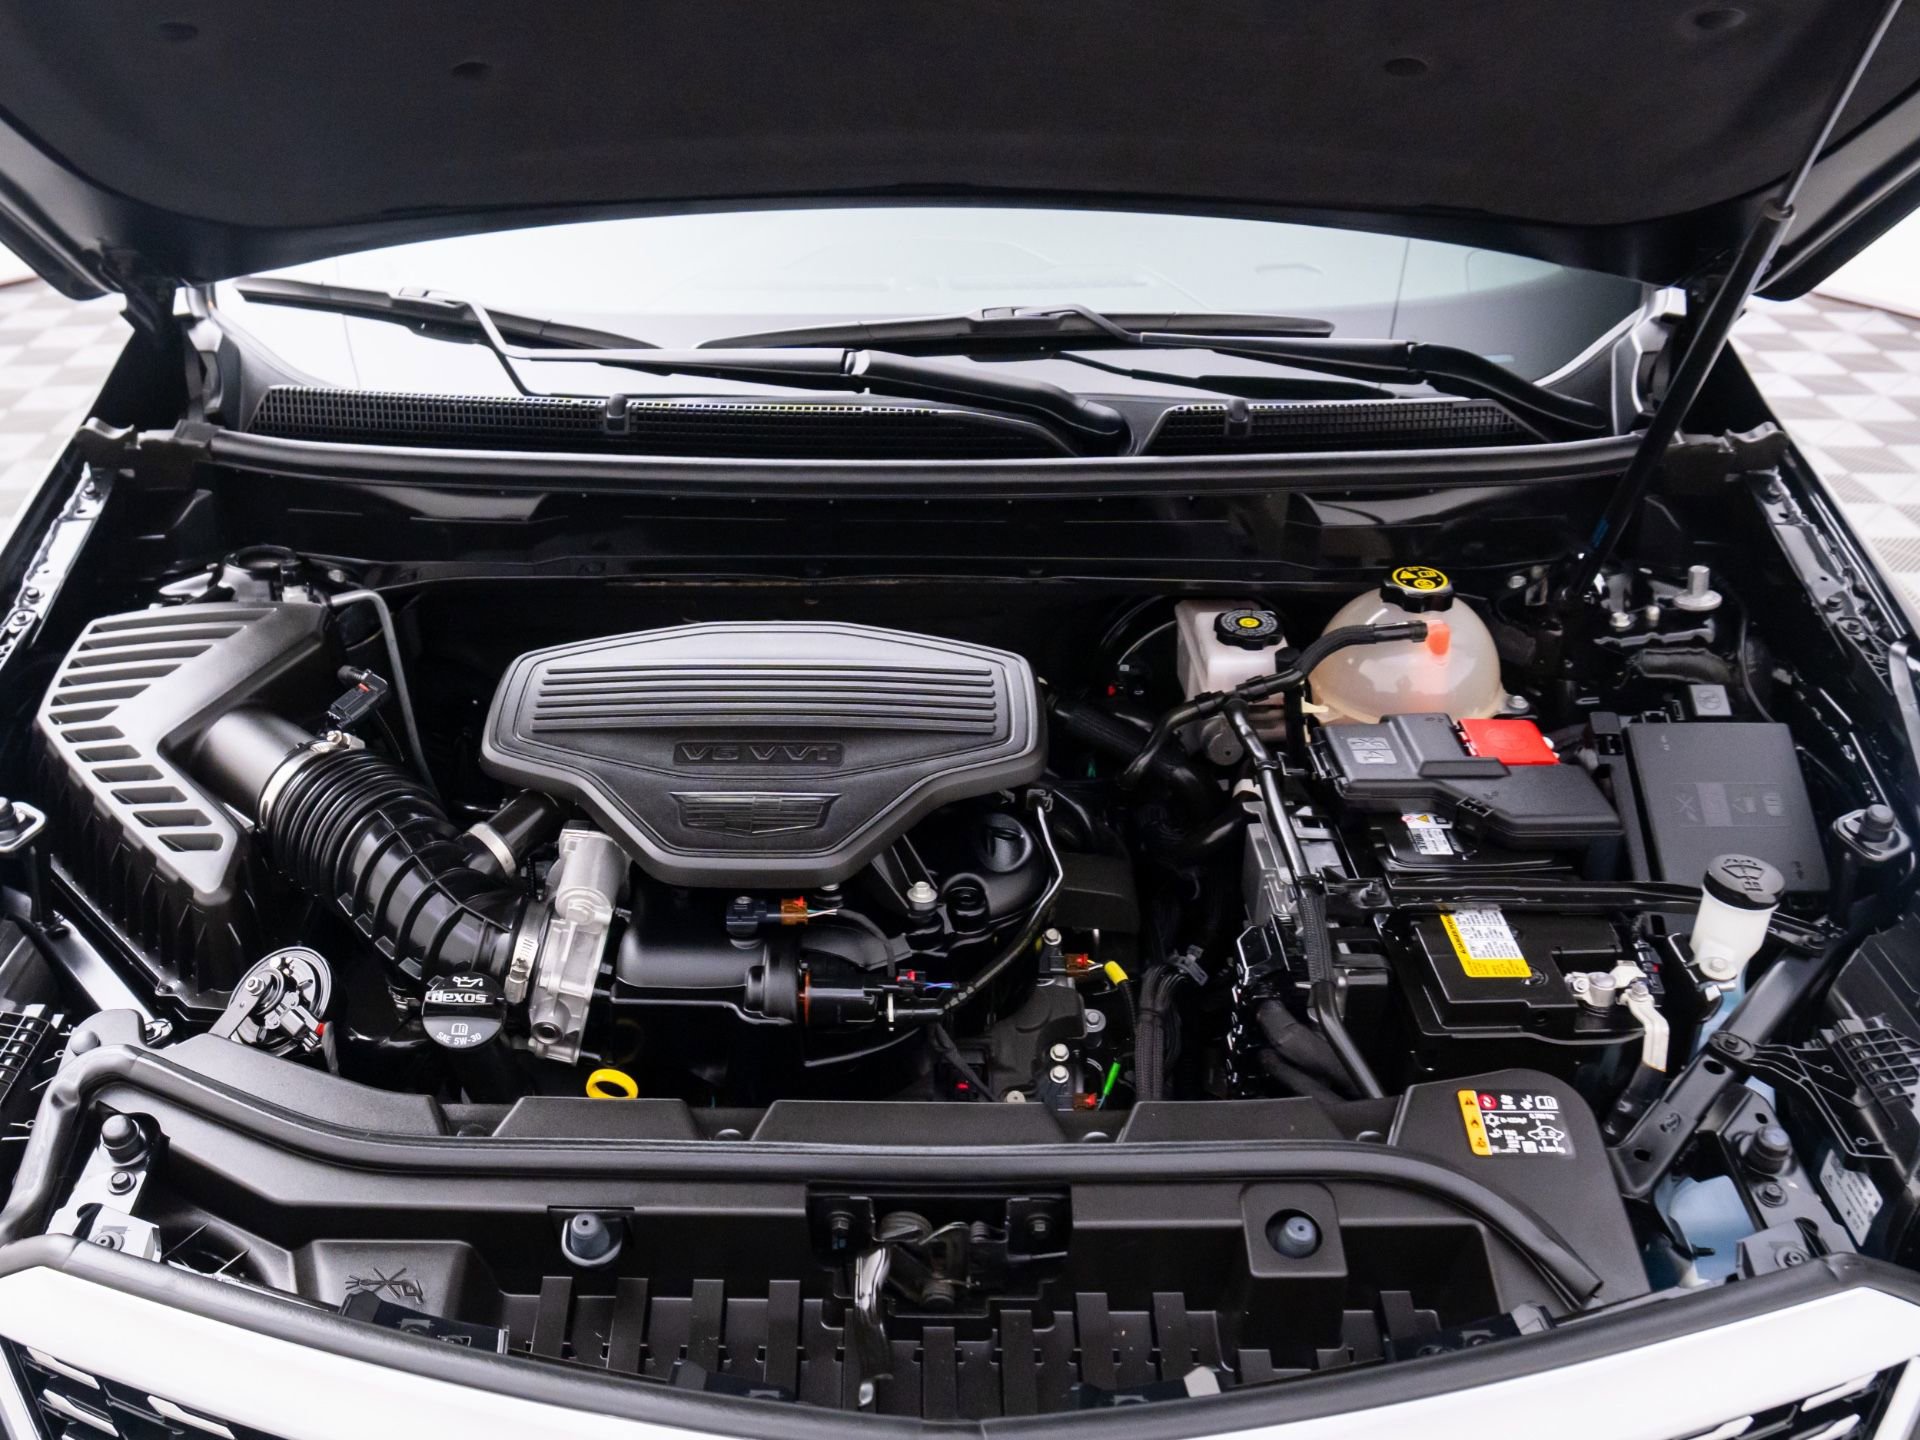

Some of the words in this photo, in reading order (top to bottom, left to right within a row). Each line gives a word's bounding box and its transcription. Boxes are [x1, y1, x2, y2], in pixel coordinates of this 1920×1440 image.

[681, 745, 739, 761] V6
[749, 745, 838, 761] VVT
[429, 990, 489, 1003] dexos
[436, 1031, 452, 1044] SAE
[453, 1032, 482, 1046] 5W-30
